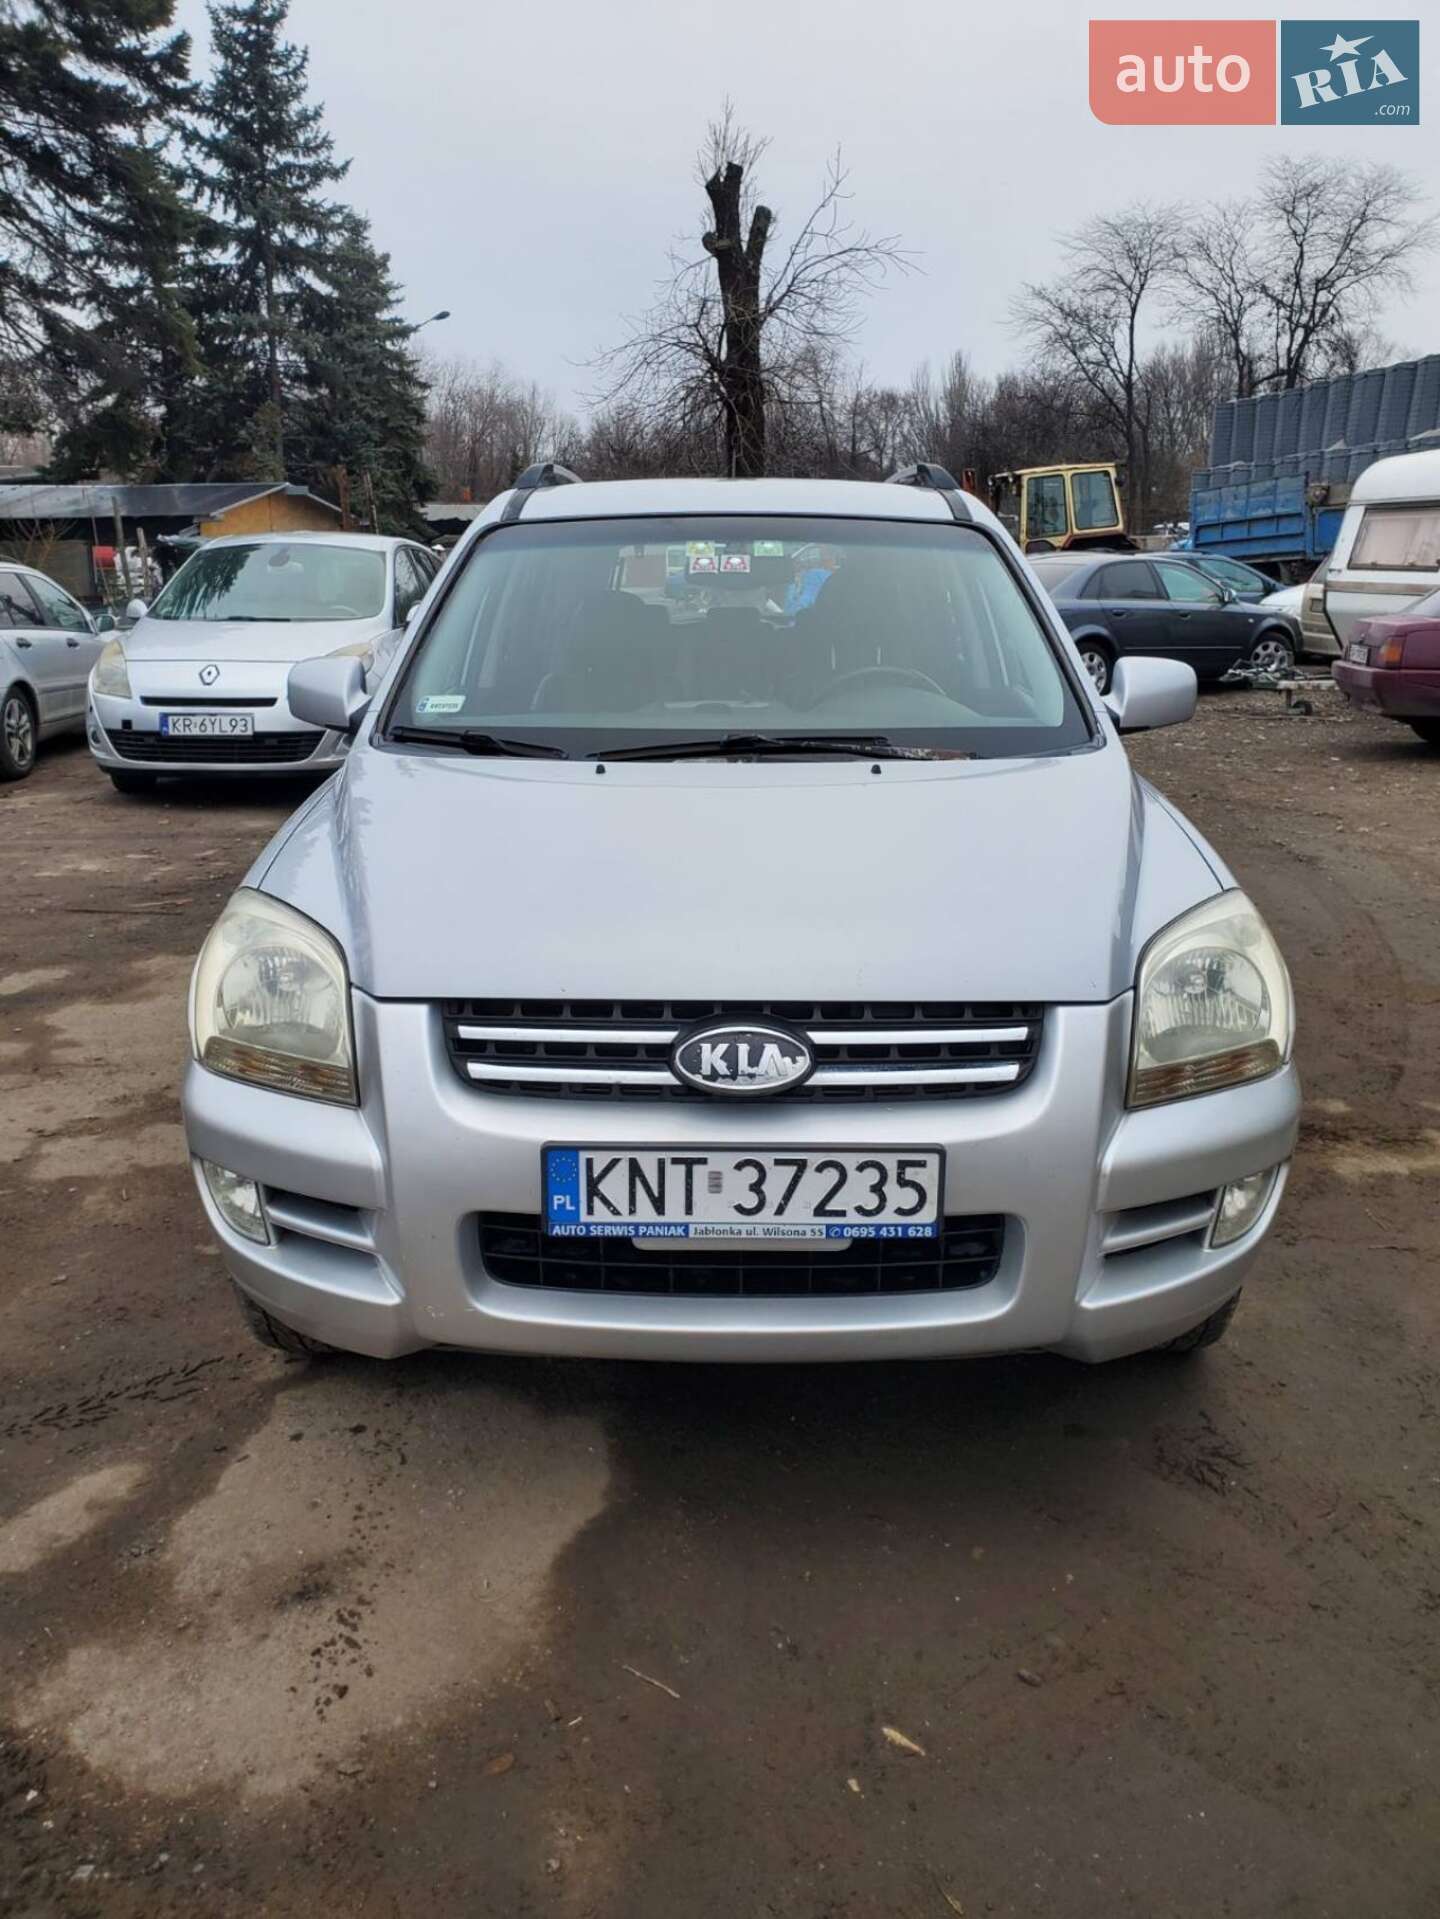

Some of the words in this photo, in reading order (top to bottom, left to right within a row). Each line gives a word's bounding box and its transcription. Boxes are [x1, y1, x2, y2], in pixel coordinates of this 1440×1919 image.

[198, 717, 248, 733] 6YL93
[585, 1157, 708, 1217] KNT
[732, 1158, 928, 1218] 37235
[553, 1195, 576, 1211] PL
[552, 1225, 586, 1237] AUTO
[590, 1225, 635, 1237] SERWIS
[639, 1225, 686, 1237] PANIAK
[745, 1227, 759, 1236] ul.
[843, 1226, 876, 1238] 0695
[879, 1226, 902, 1238] 431
[907, 1226, 933, 1238] 628
